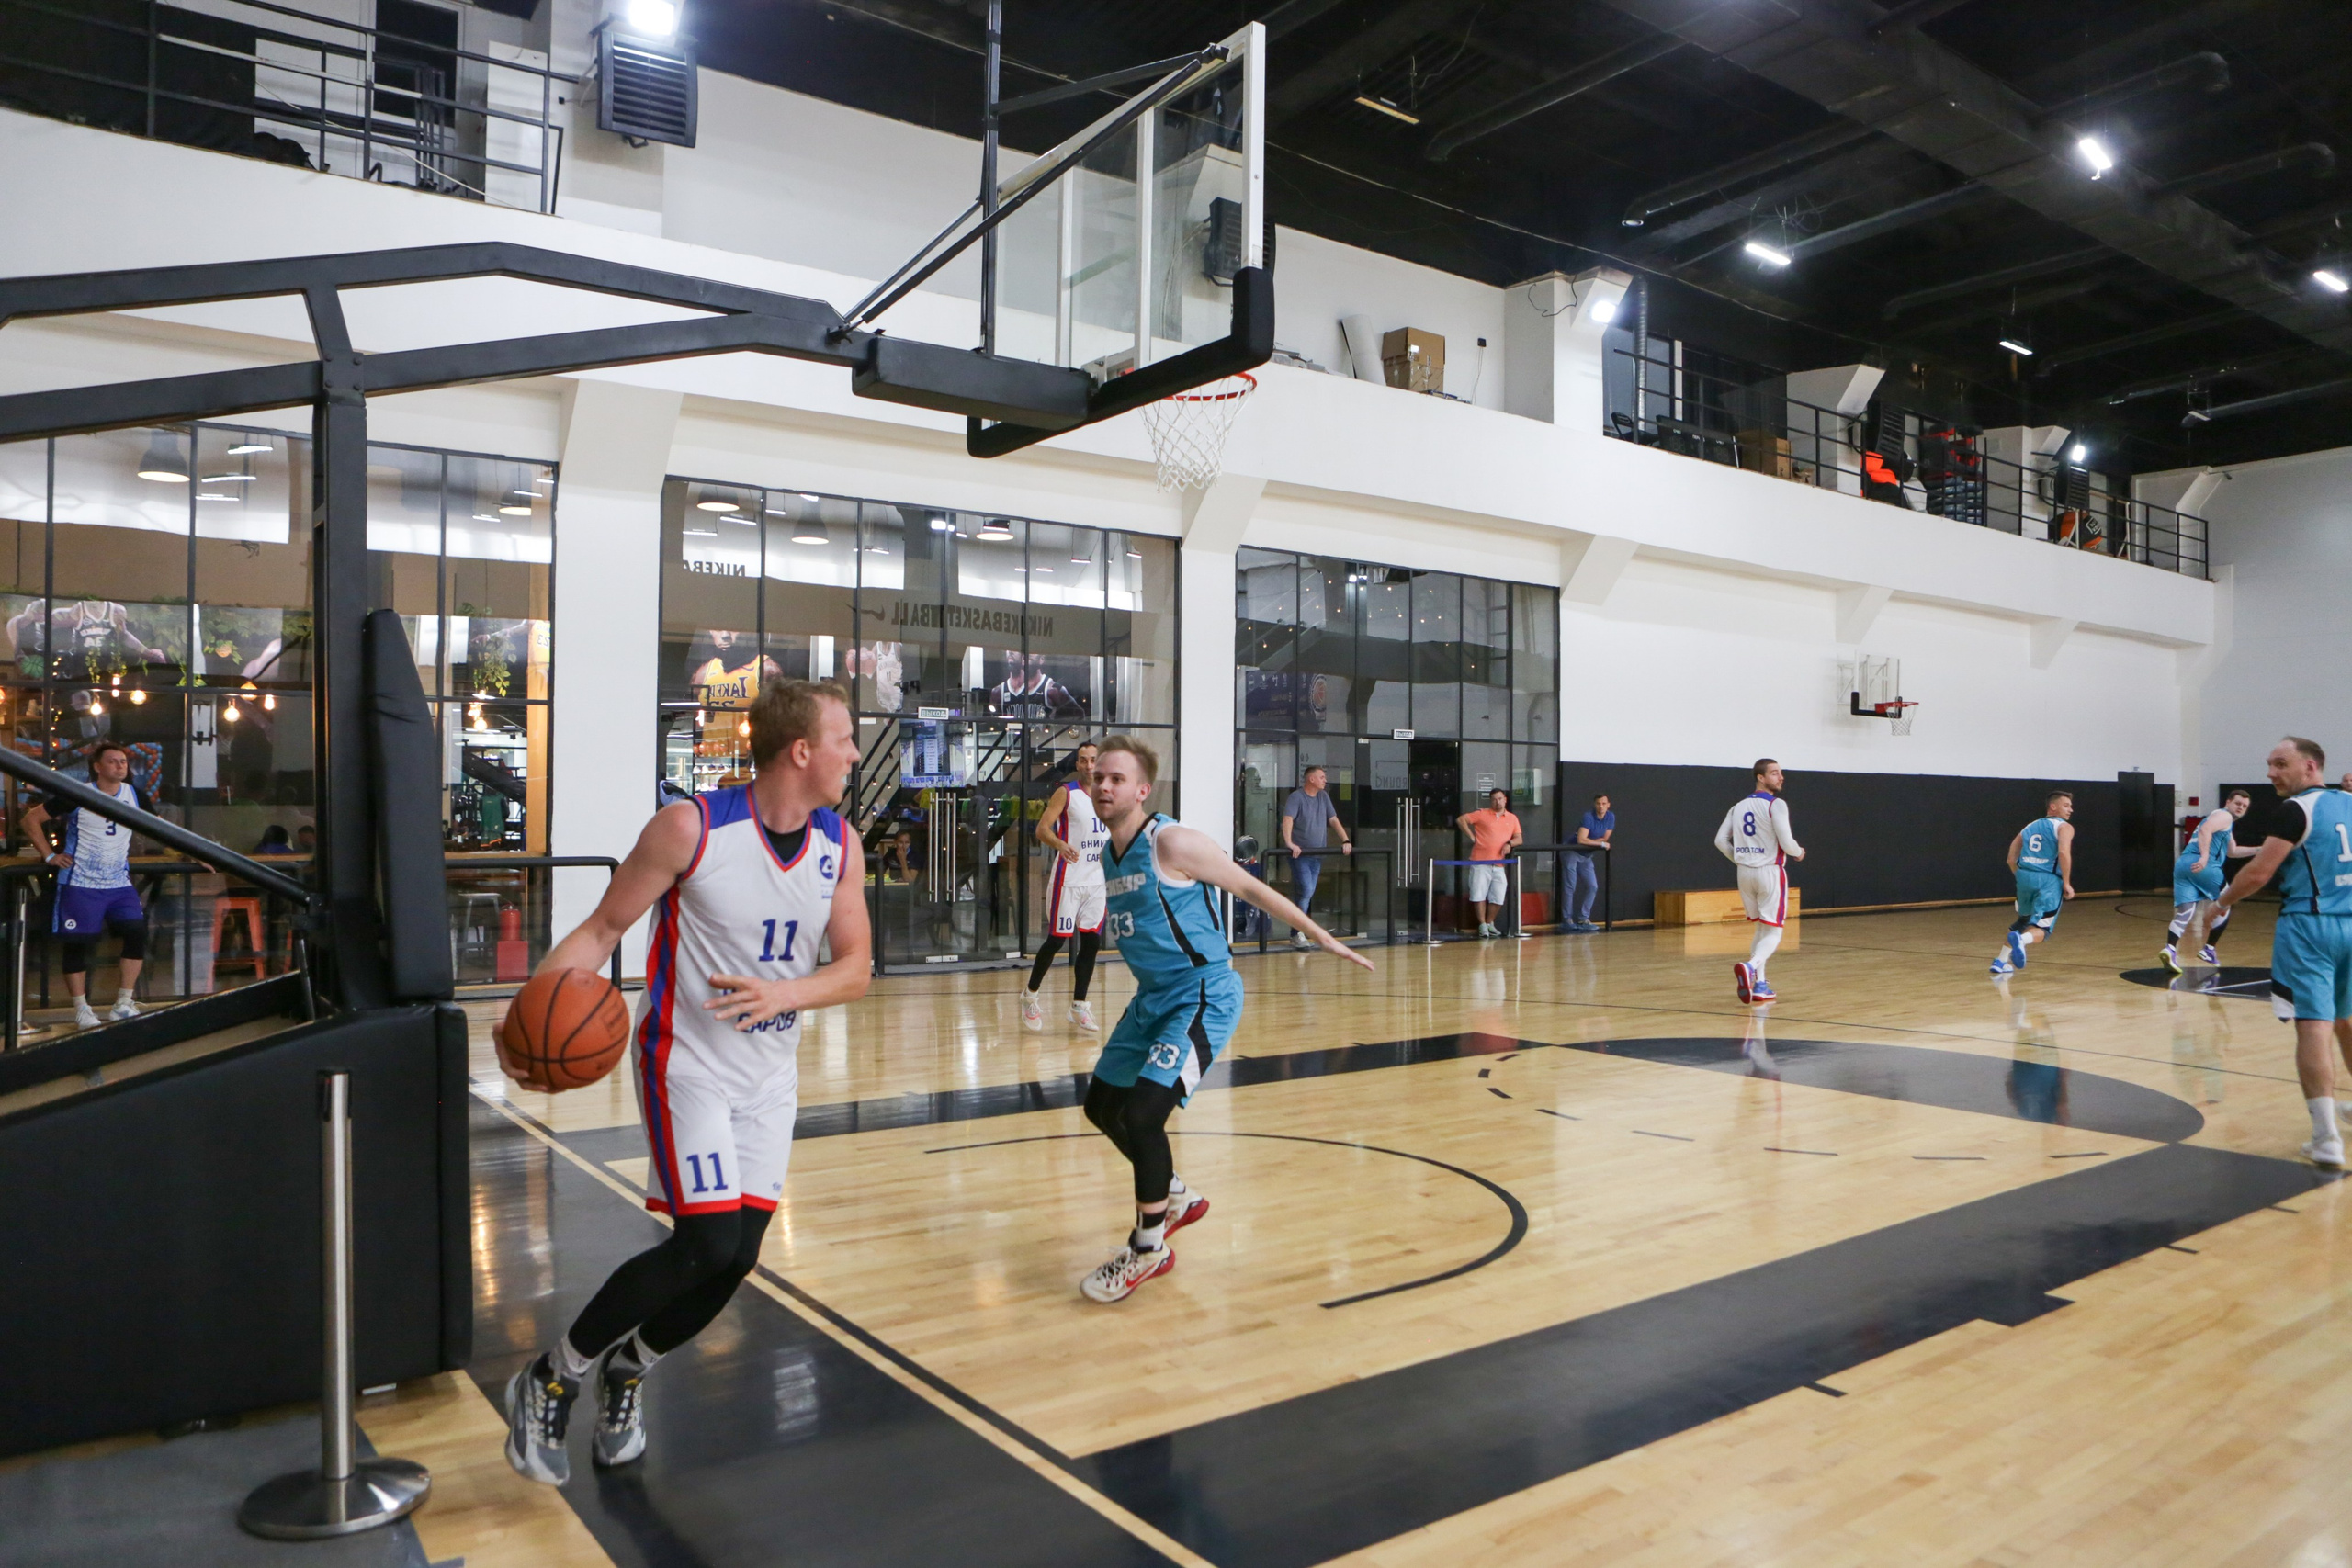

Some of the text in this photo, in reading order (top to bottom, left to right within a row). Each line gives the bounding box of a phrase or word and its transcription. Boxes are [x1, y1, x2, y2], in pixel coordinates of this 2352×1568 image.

[1091, 817, 1107, 833] 10
[1743, 811, 1757, 837] 8
[2029, 833, 2042, 852] 6
[1086, 853, 1101, 862] САР
[1058, 917, 1073, 931] 10
[1110, 911, 1135, 941] 33
[758, 919, 798, 962] 11
[685, 1151, 729, 1193] 11
